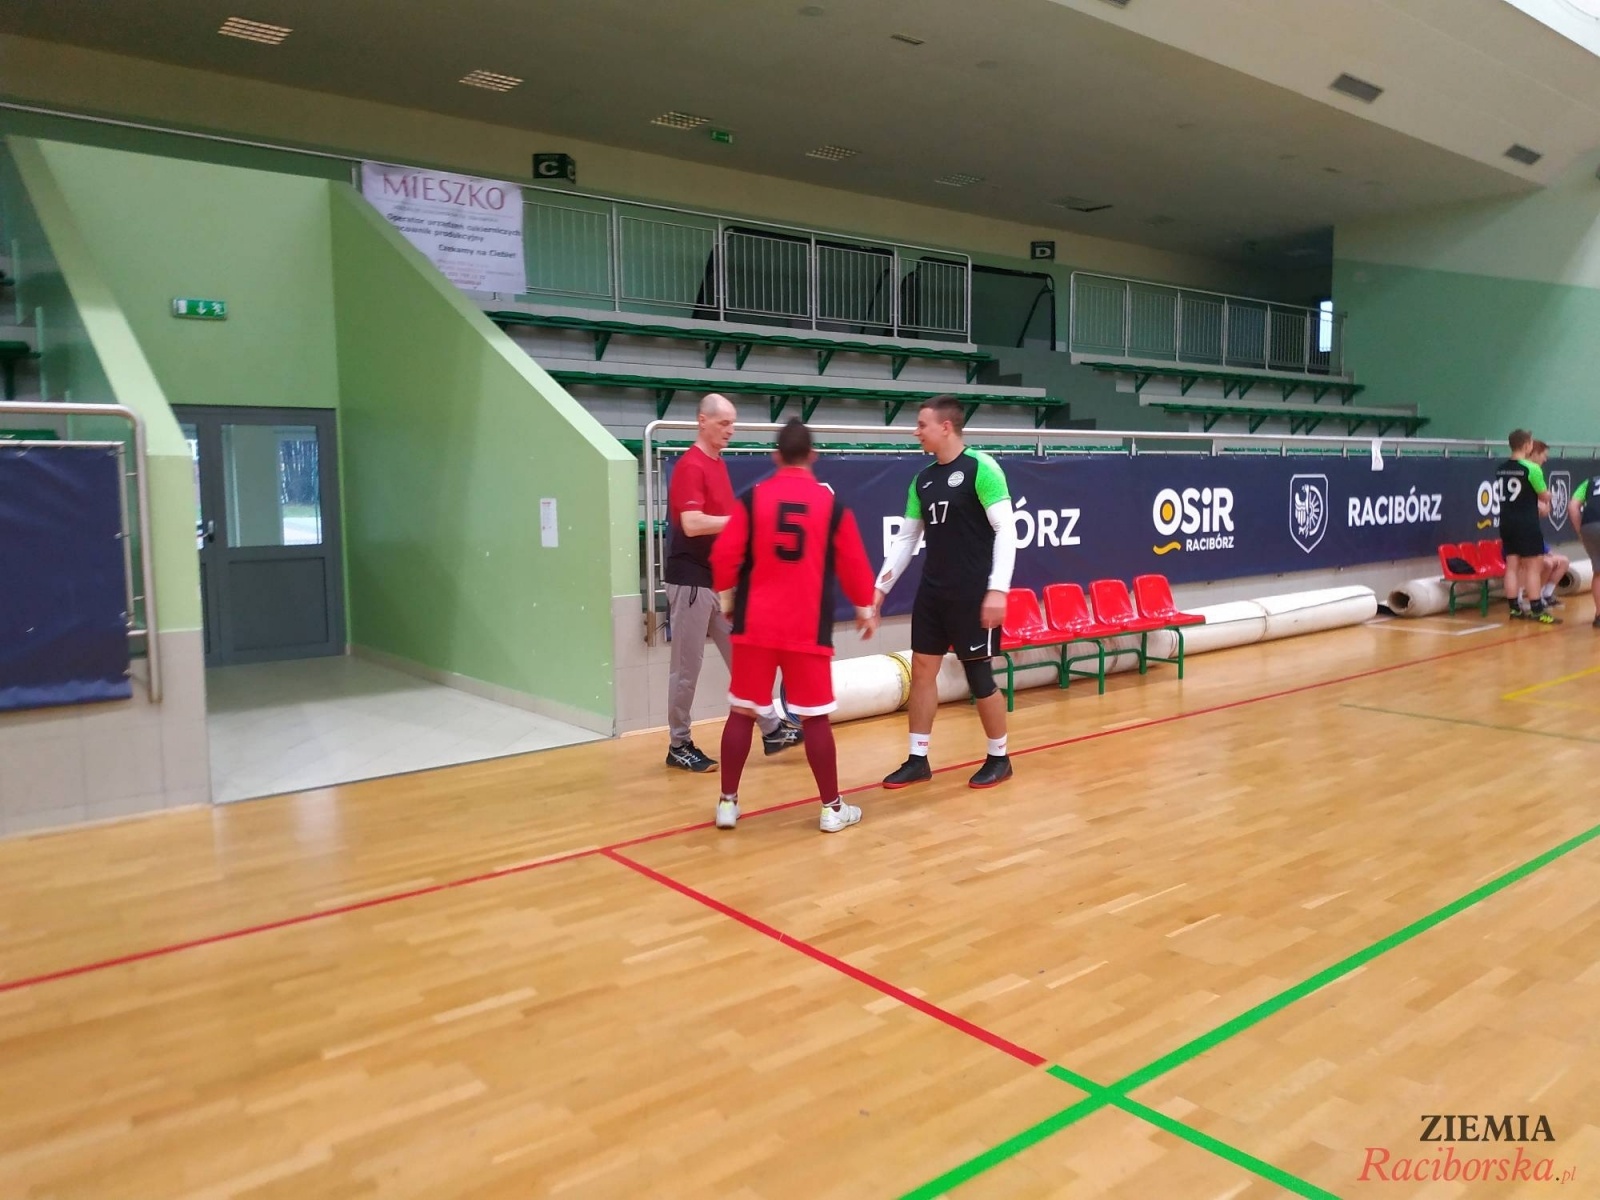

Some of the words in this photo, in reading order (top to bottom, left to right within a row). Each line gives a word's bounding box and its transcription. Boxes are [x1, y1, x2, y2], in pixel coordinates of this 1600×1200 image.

[538, 161, 559, 176] C
[383, 172, 505, 211] MIESZKO
[1035, 247, 1051, 258] D
[1477, 480, 1500, 516] OS
[1498, 476, 1522, 502] 19
[928, 501, 949, 525] 17
[1349, 485, 1442, 527] RACIBÓRZ
[774, 501, 808, 562] 5
[1185, 533, 1235, 552] RACIBÓRZ
